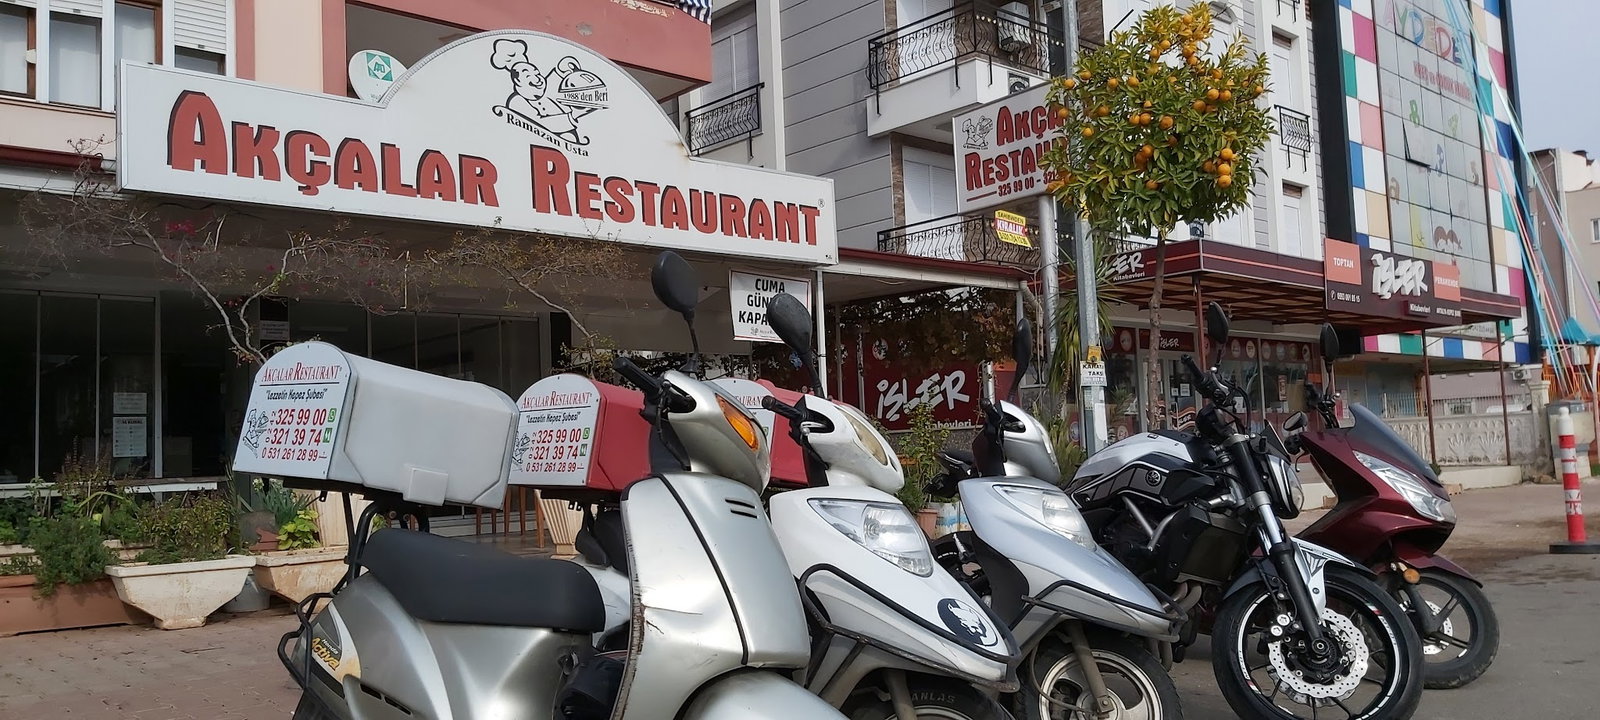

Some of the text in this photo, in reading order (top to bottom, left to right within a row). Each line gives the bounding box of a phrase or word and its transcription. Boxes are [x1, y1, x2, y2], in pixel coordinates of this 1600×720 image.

[505, 112, 589, 157] Ramazan Usta
[167, 89, 821, 246] AKÇALAR RESTAURANT
[998, 184, 1012, 197] 325
[1013, 179, 1023, 193] 99
[1024, 176, 1035, 189] 00
[1333, 256, 1354, 269] TOPTAN
[755, 278, 785, 293] CUMA
[738, 310, 769, 326] KAPA
[294, 362, 340, 381] RESTAURANT
[549, 391, 590, 407] RESTAURANT
[276, 408, 327, 426] 325 99 00
[271, 428, 322, 446] 321 39 74
[536, 428, 581, 444] 325 99 00
[261, 447, 318, 461] 0 531 261 28 99
[533, 445, 579, 460] 321 39 74
[525, 462, 577, 473] 0 531 261 28 99
[311, 637, 340, 672] Activa
